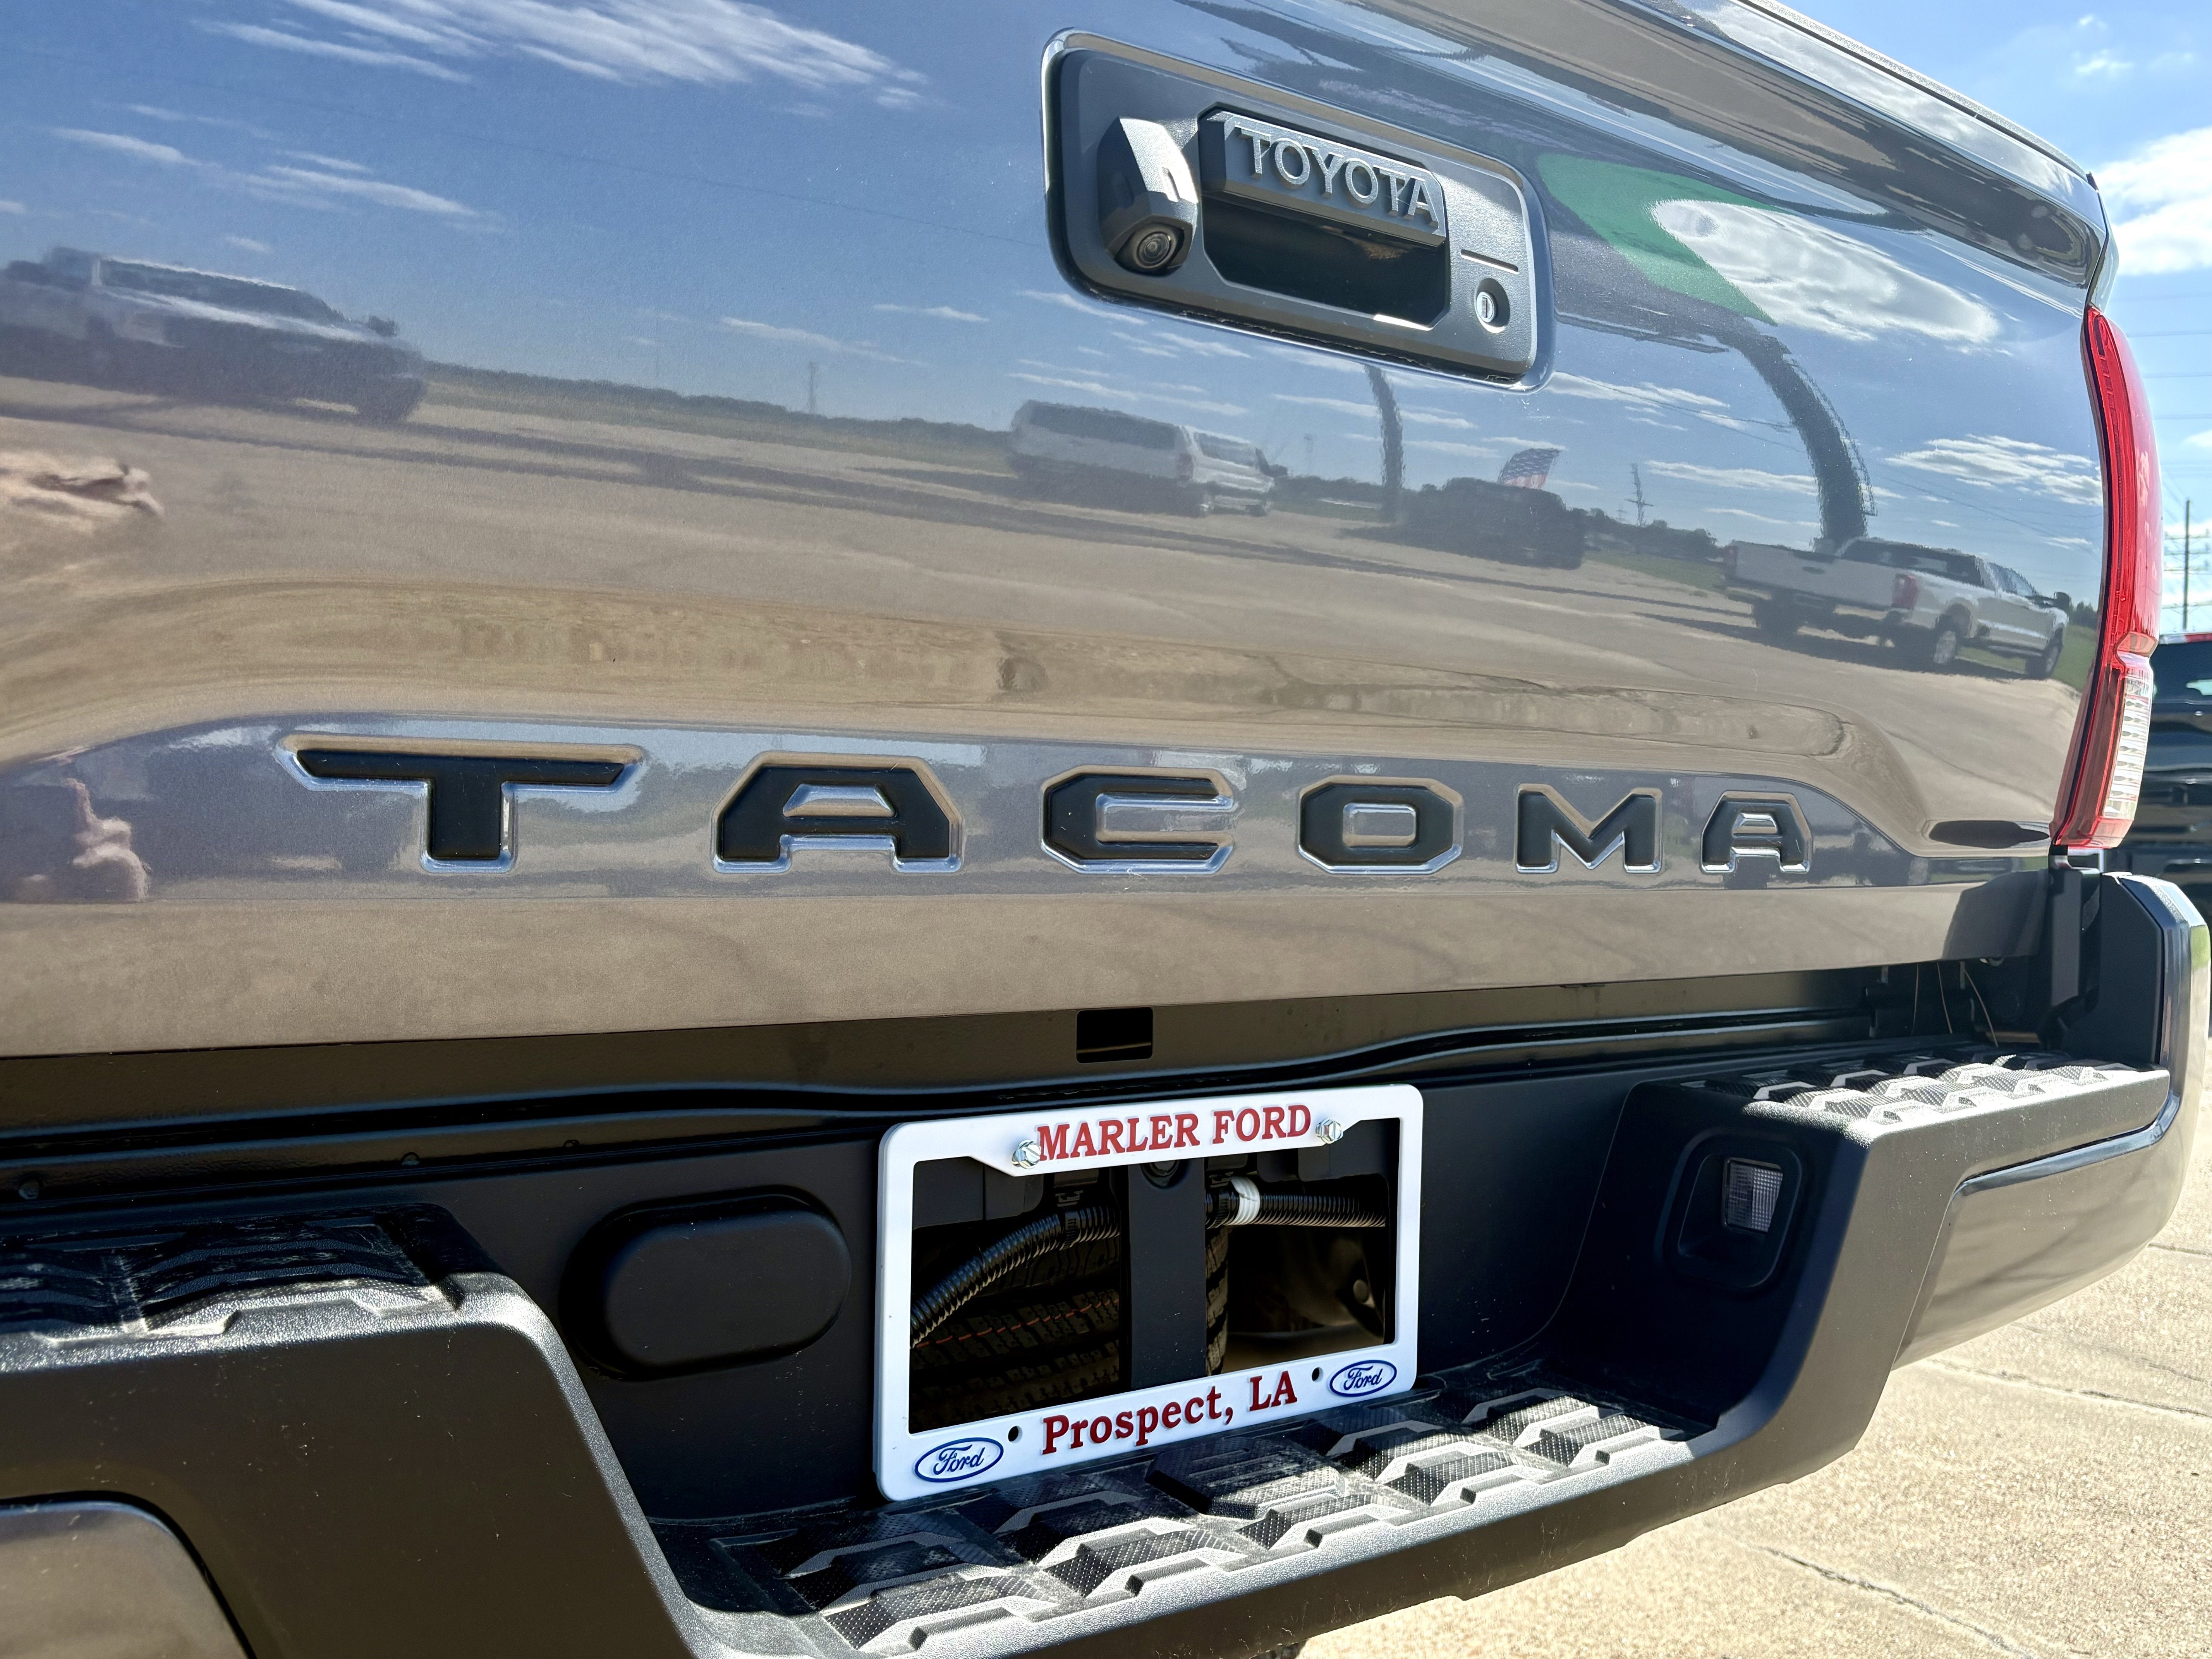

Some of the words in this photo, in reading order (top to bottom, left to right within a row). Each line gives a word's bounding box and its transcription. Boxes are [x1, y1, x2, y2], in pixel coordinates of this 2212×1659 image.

[1235, 125, 1439, 225] TOYOTA
[285, 736, 1812, 874] TACOMA
[1037, 1113, 1200, 1161] MARLER
[1213, 1105, 1311, 1144] FORD
[1042, 1386, 1234, 1455] Prospect,
[1250, 1371, 1297, 1412] LA
[1342, 1365, 1384, 1392] Ford
[932, 1444, 986, 1475] Ford
